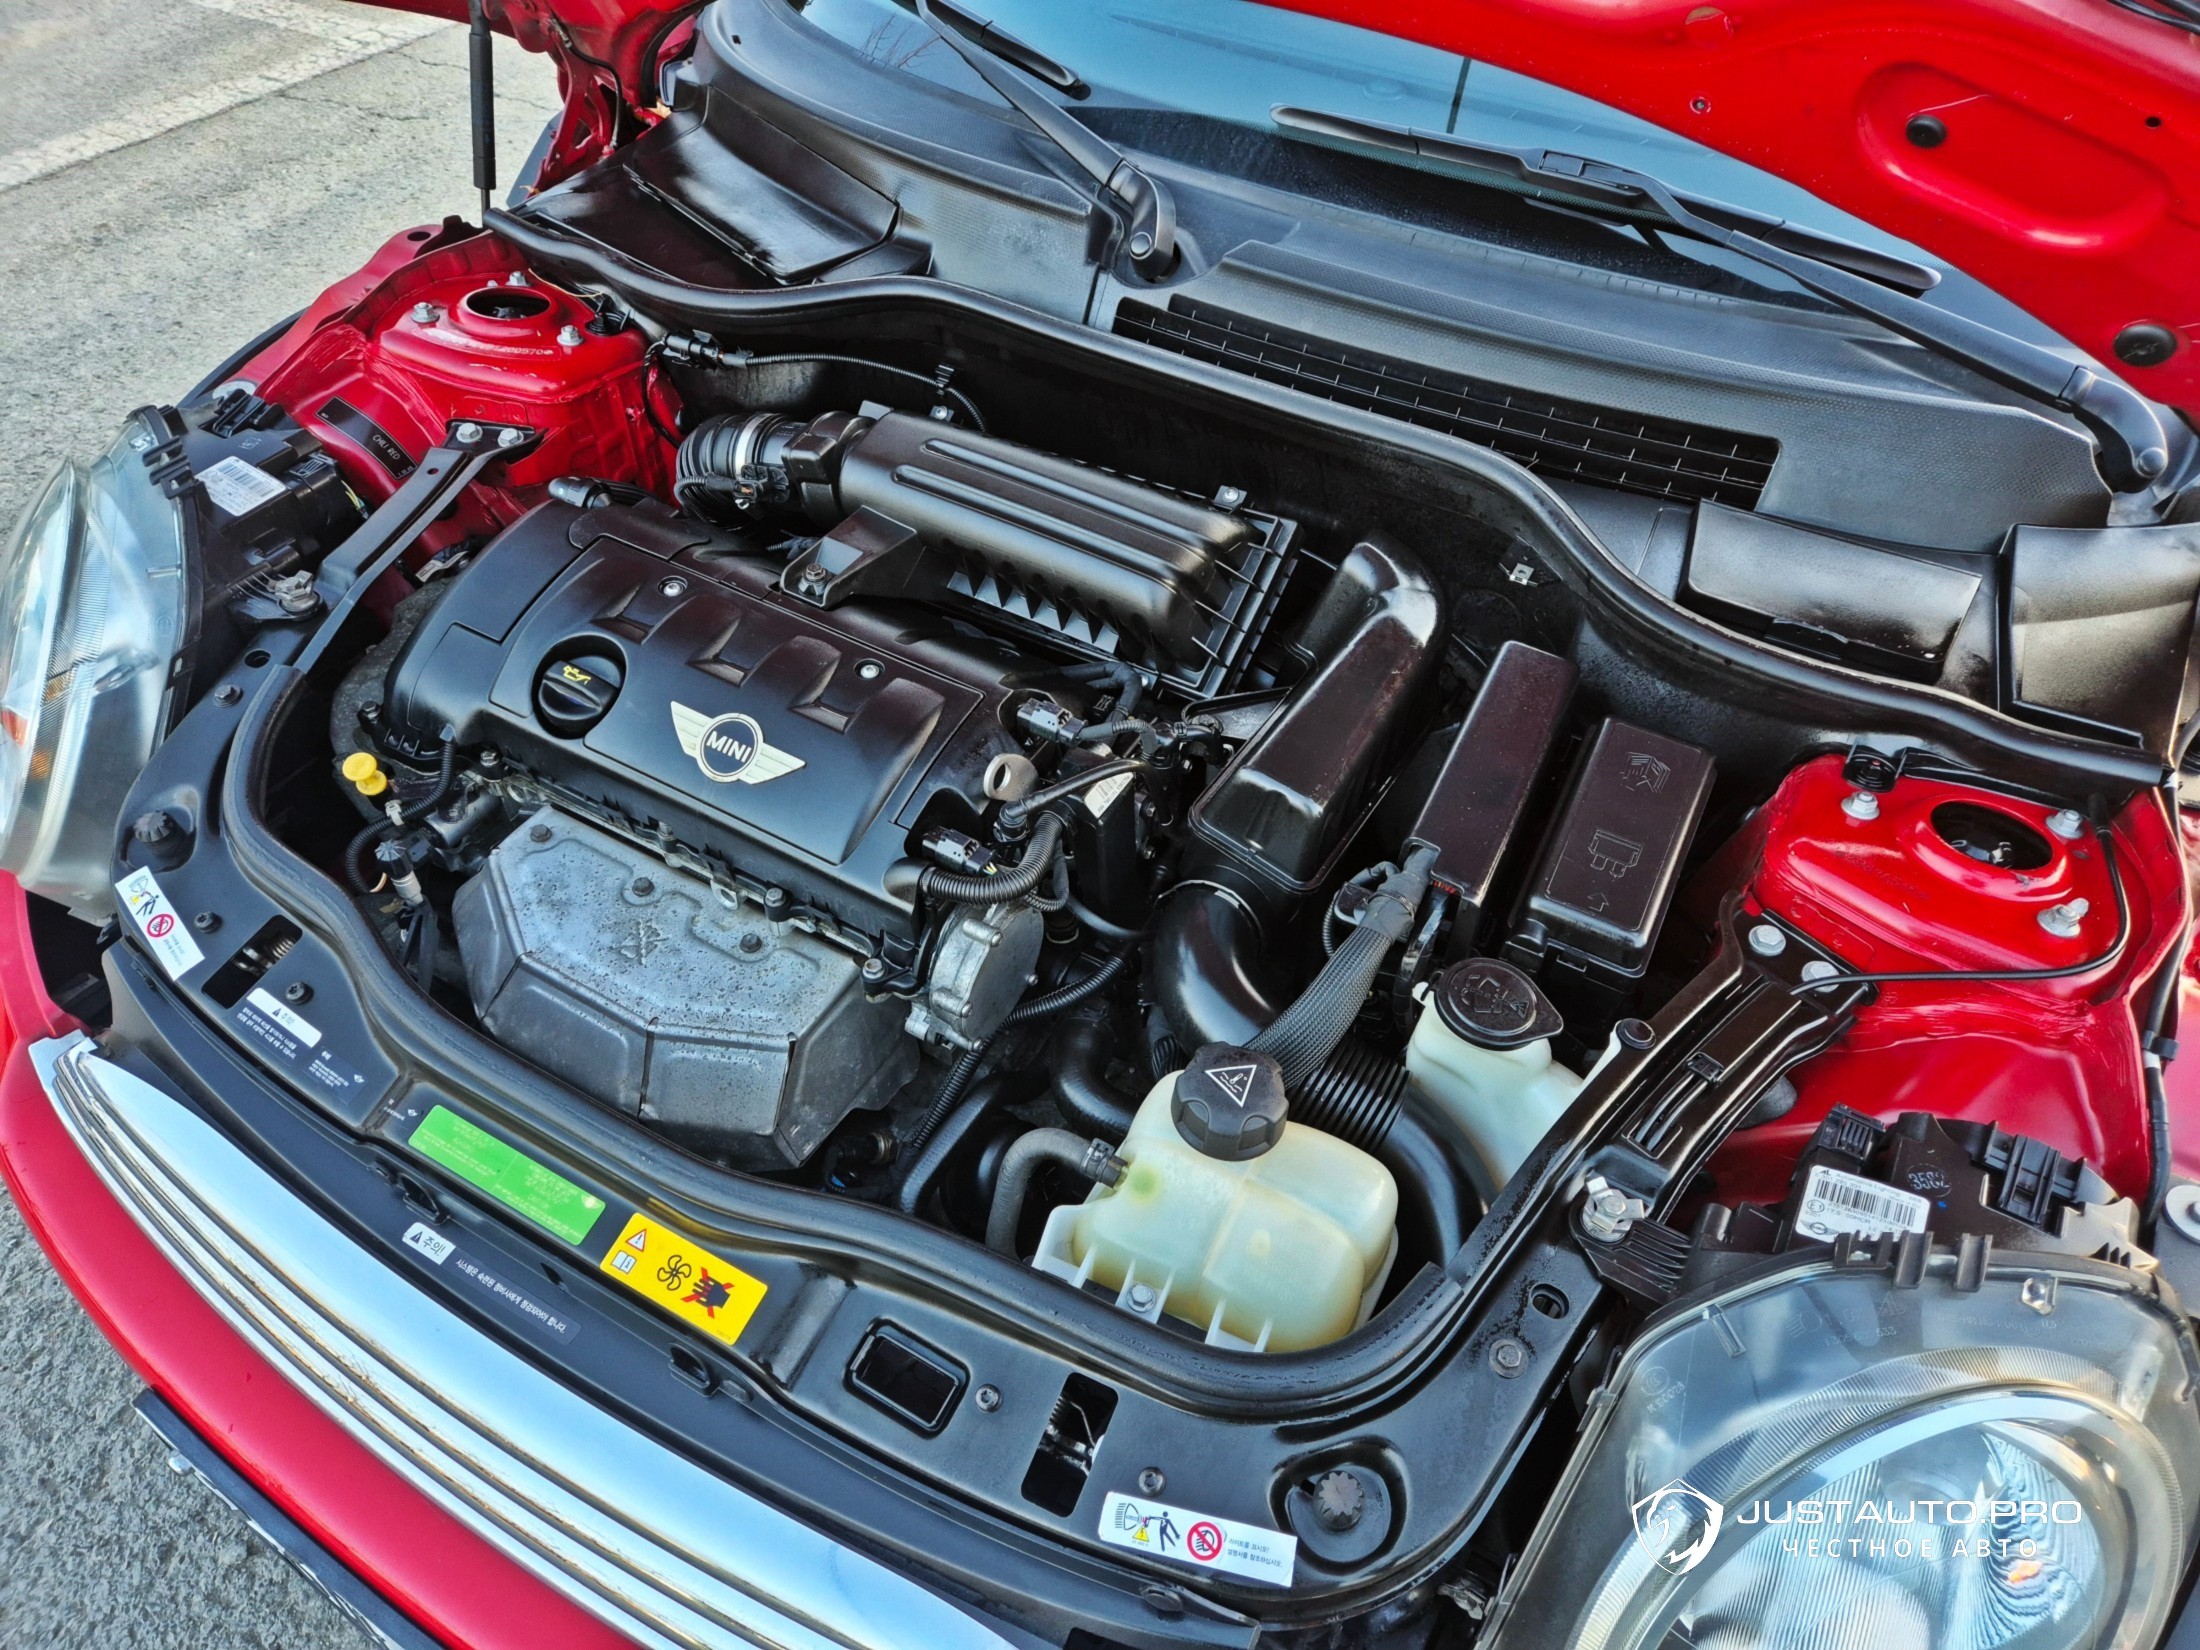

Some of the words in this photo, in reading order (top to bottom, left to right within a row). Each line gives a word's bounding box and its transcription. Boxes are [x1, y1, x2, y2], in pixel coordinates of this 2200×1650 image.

[372, 434, 390, 449] CHILI
[386, 447, 401, 460] RED
[706, 730, 752, 763] MINI
[1874, 1184, 1901, 1197] Lighting
[423, 1236, 446, 1256] 주의!
[455, 1259, 479, 1278] 시스템은
[477, 1270, 496, 1287] 숙련된
[493, 1282, 522, 1304] 정비사에게
